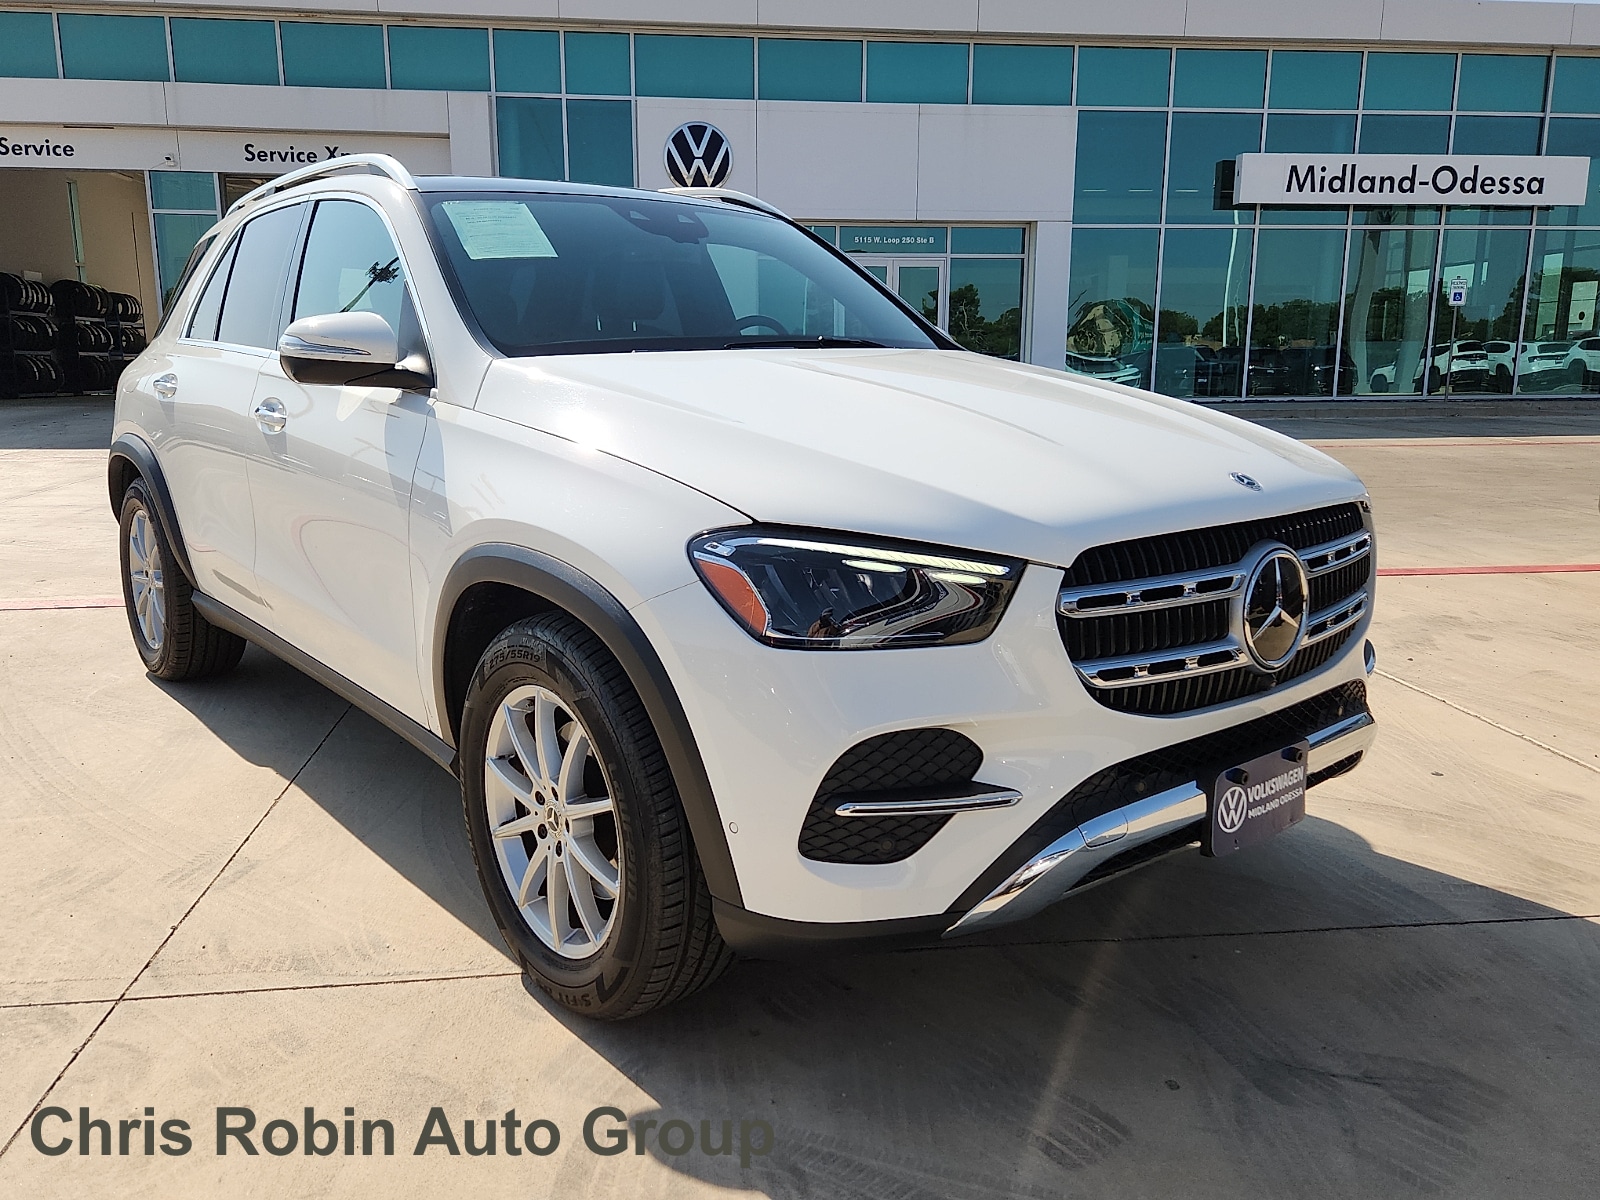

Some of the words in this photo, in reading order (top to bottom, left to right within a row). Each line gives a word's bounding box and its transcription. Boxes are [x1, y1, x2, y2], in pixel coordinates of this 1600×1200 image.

[0, 137, 75, 157] Service
[244, 143, 318, 163] Service
[1286, 164, 1545, 195] Midland-Odessa
[883, 237, 900, 245] Loop
[489, 649, 541, 670] 275/55R19
[1247, 766, 1304, 803] VOLKSWAGEN
[1247, 798, 1279, 819] MIDLAND
[1279, 787, 1303, 805] ODESSA
